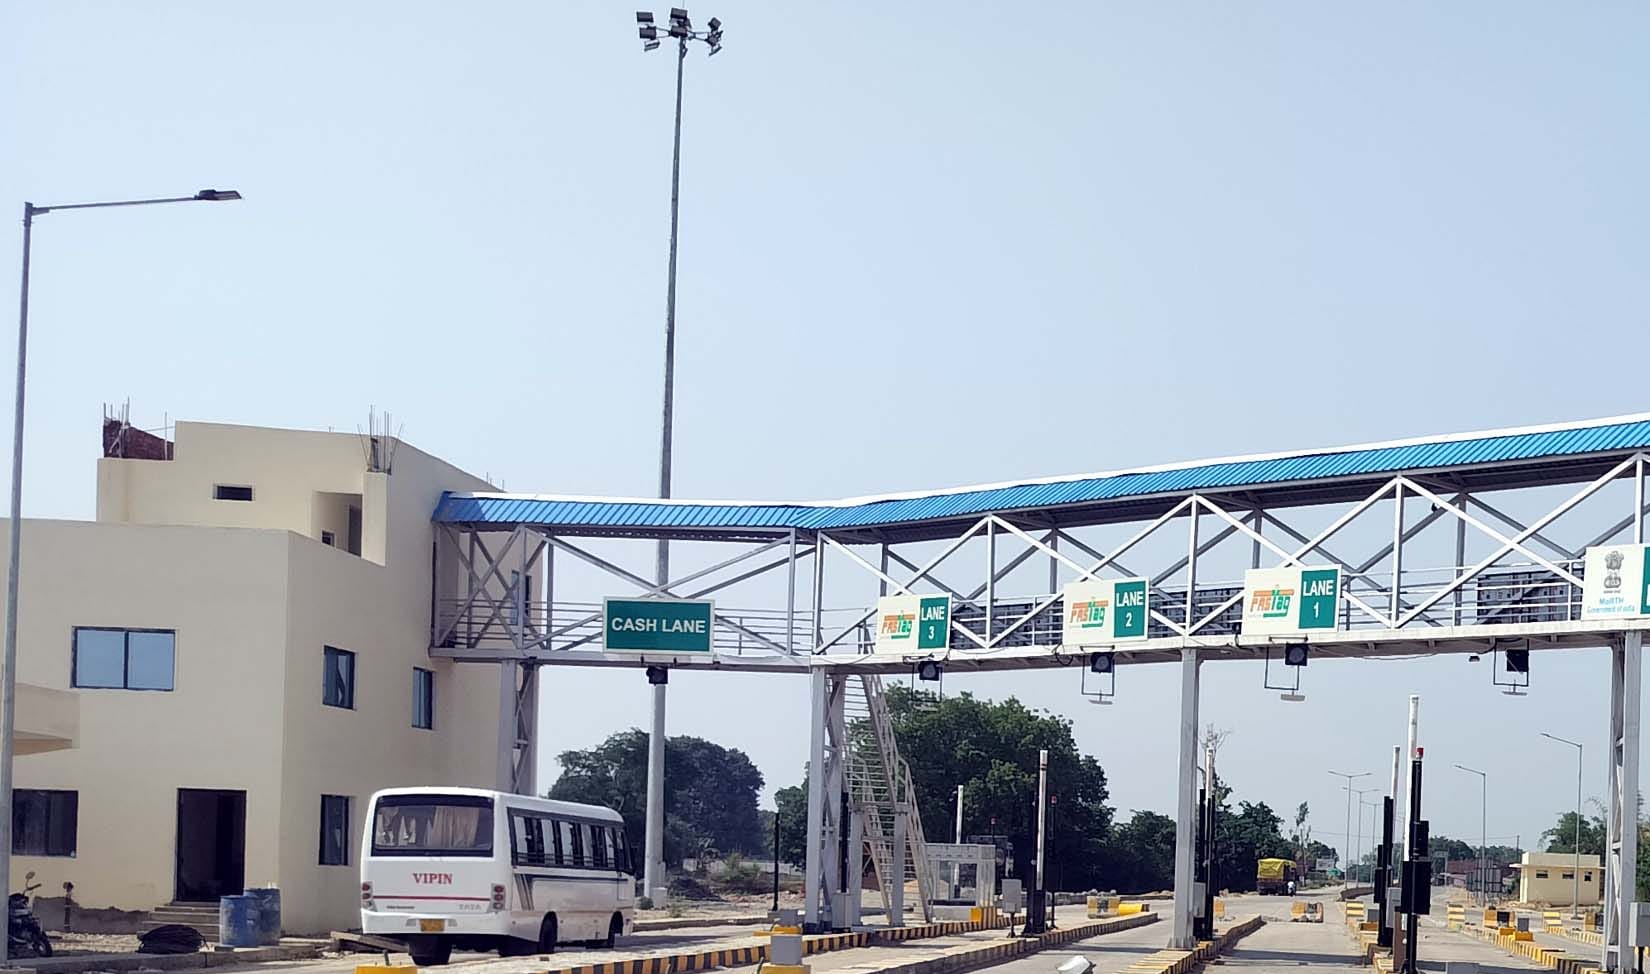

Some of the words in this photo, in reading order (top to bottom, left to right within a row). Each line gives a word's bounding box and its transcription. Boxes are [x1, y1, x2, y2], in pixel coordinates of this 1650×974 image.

[1302, 579, 1334, 597] LANE
[1116, 590, 1144, 607] LANE
[921, 606, 946, 620] LANE
[1313, 601, 1320, 619] 1
[611, 617, 657, 632] CASH
[661, 618, 706, 634] LANE
[1125, 612, 1133, 628] 2
[928, 625, 935, 640] 3
[413, 872, 453, 885] VIPIN
[458, 903, 482, 911] TATA
